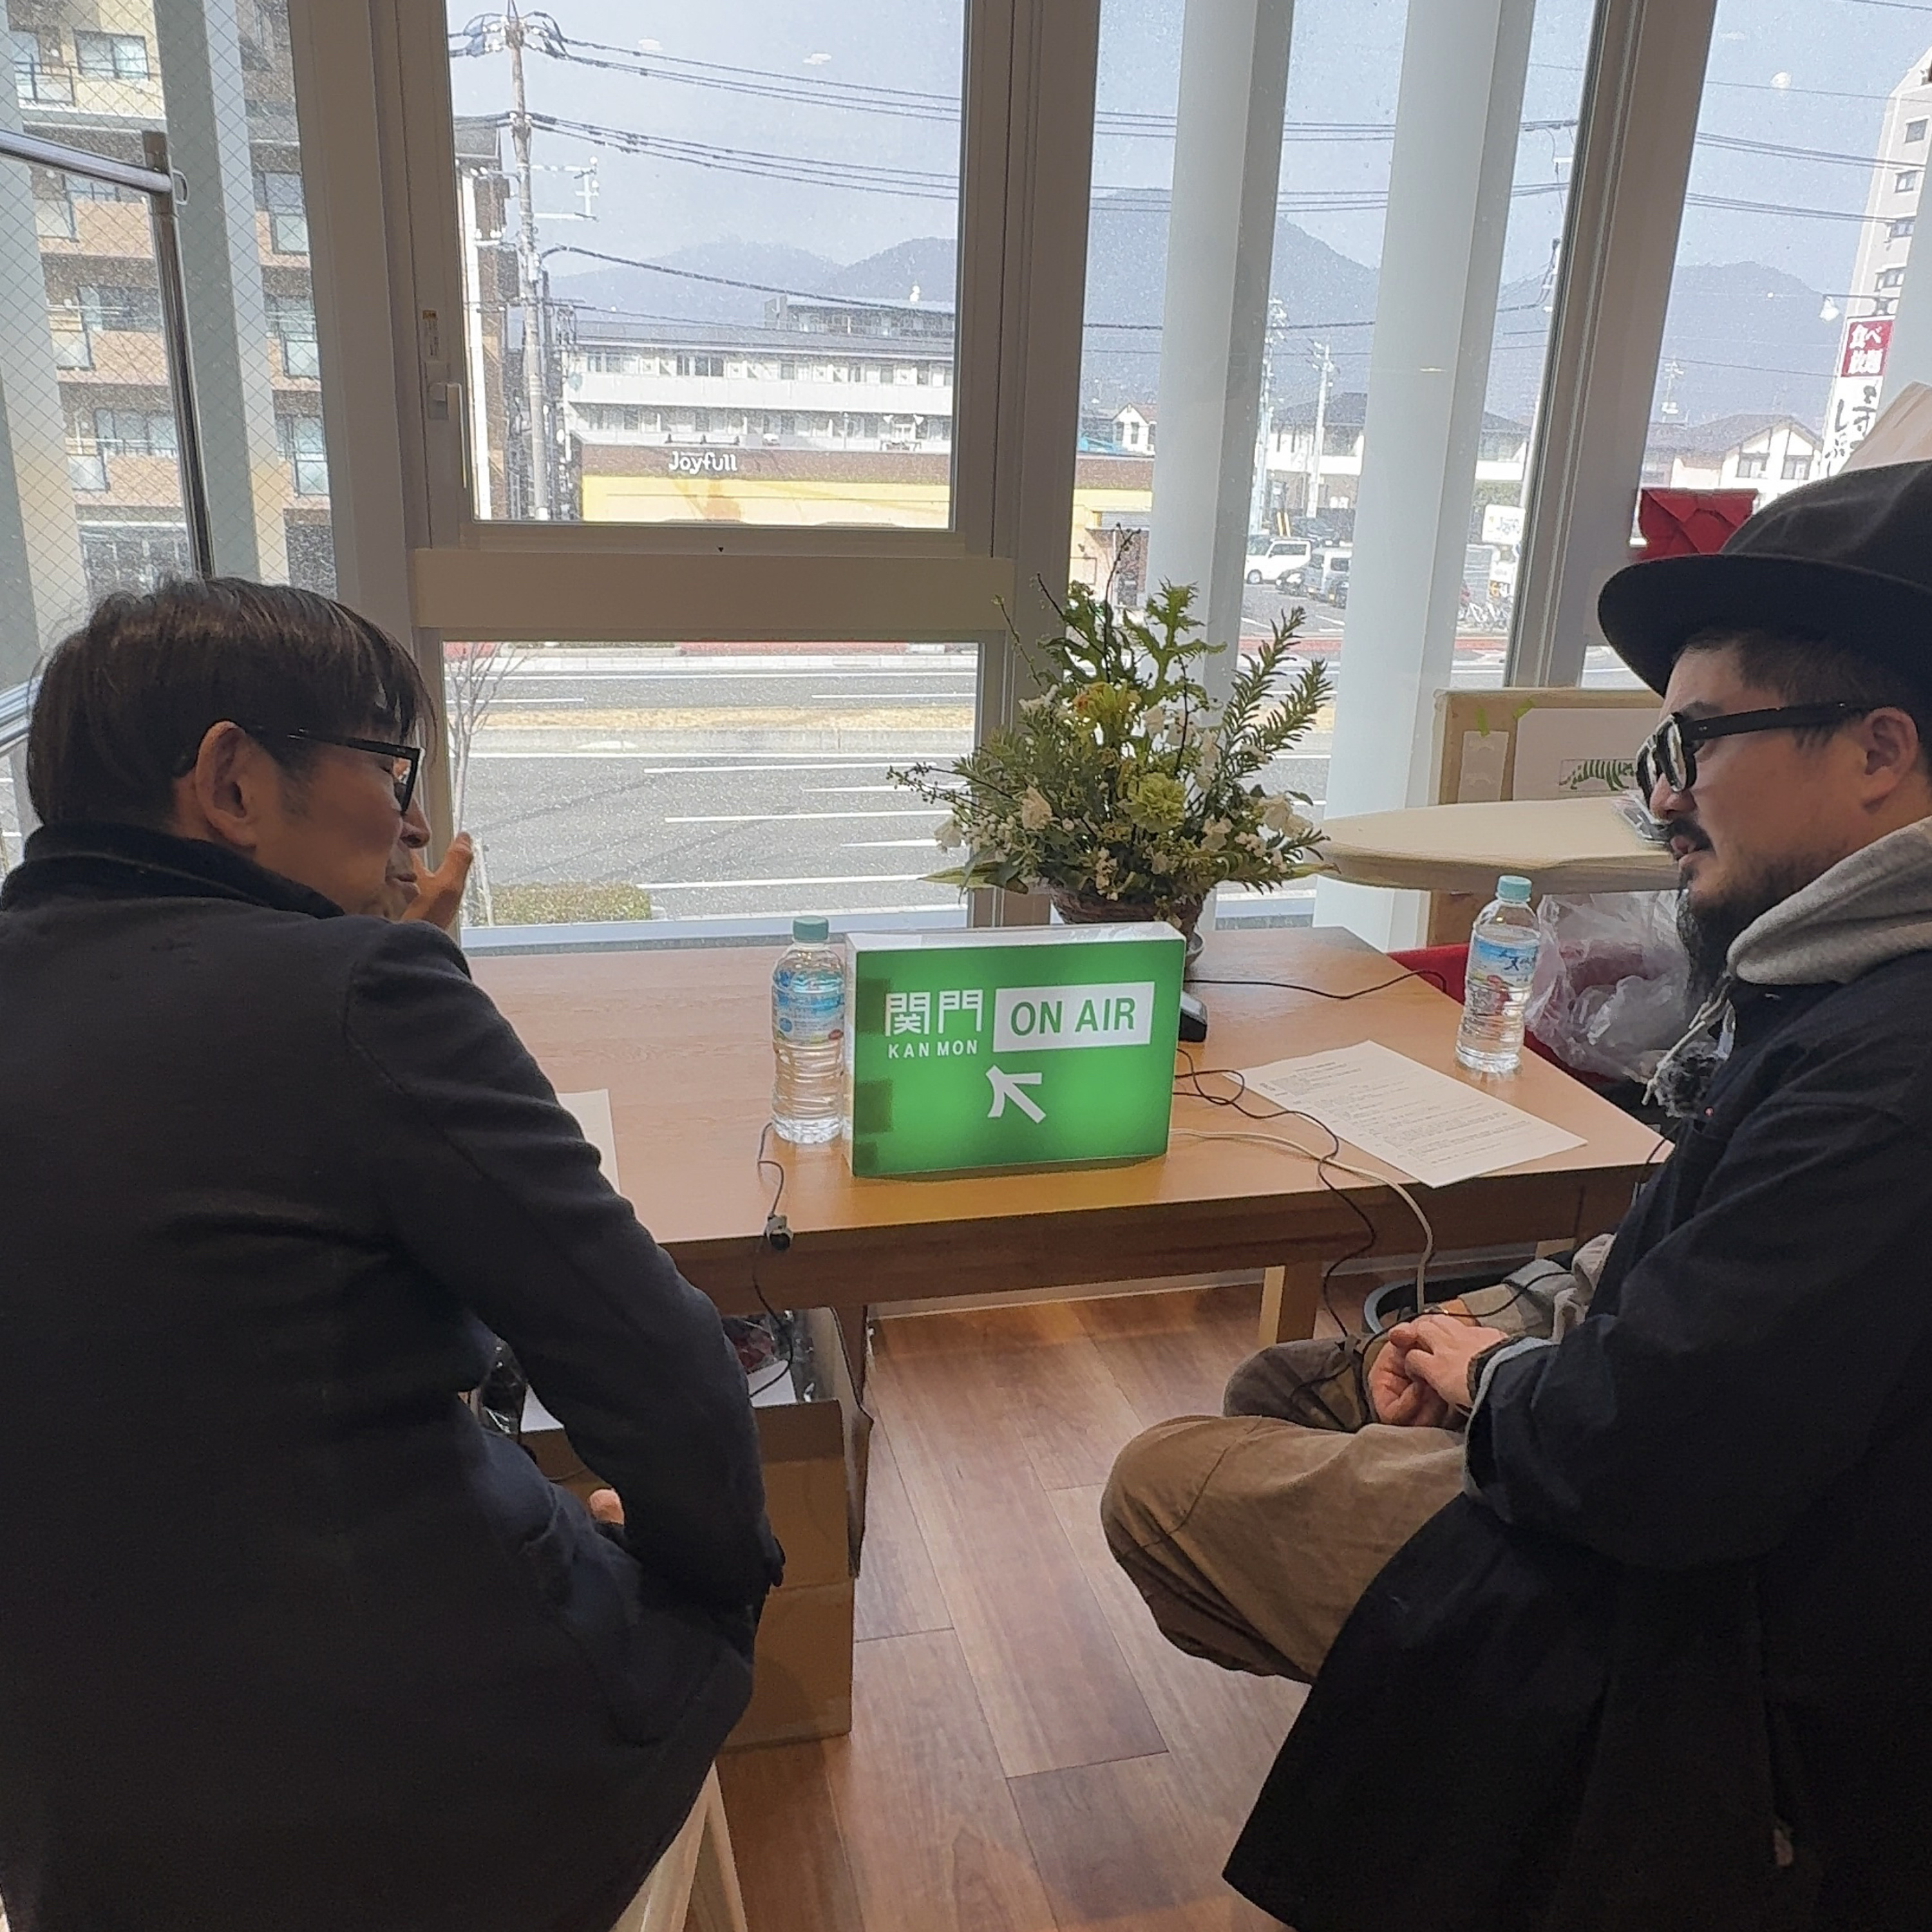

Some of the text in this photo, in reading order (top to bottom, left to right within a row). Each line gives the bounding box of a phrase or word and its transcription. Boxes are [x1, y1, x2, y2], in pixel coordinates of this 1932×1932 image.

[1849, 323, 1882, 349] 食べ
[668, 450, 738, 475] Joyfull
[885, 989, 984, 1037] 関門
[1010, 1000, 1063, 1037] ON
[1074, 997, 1136, 1033] AIR
